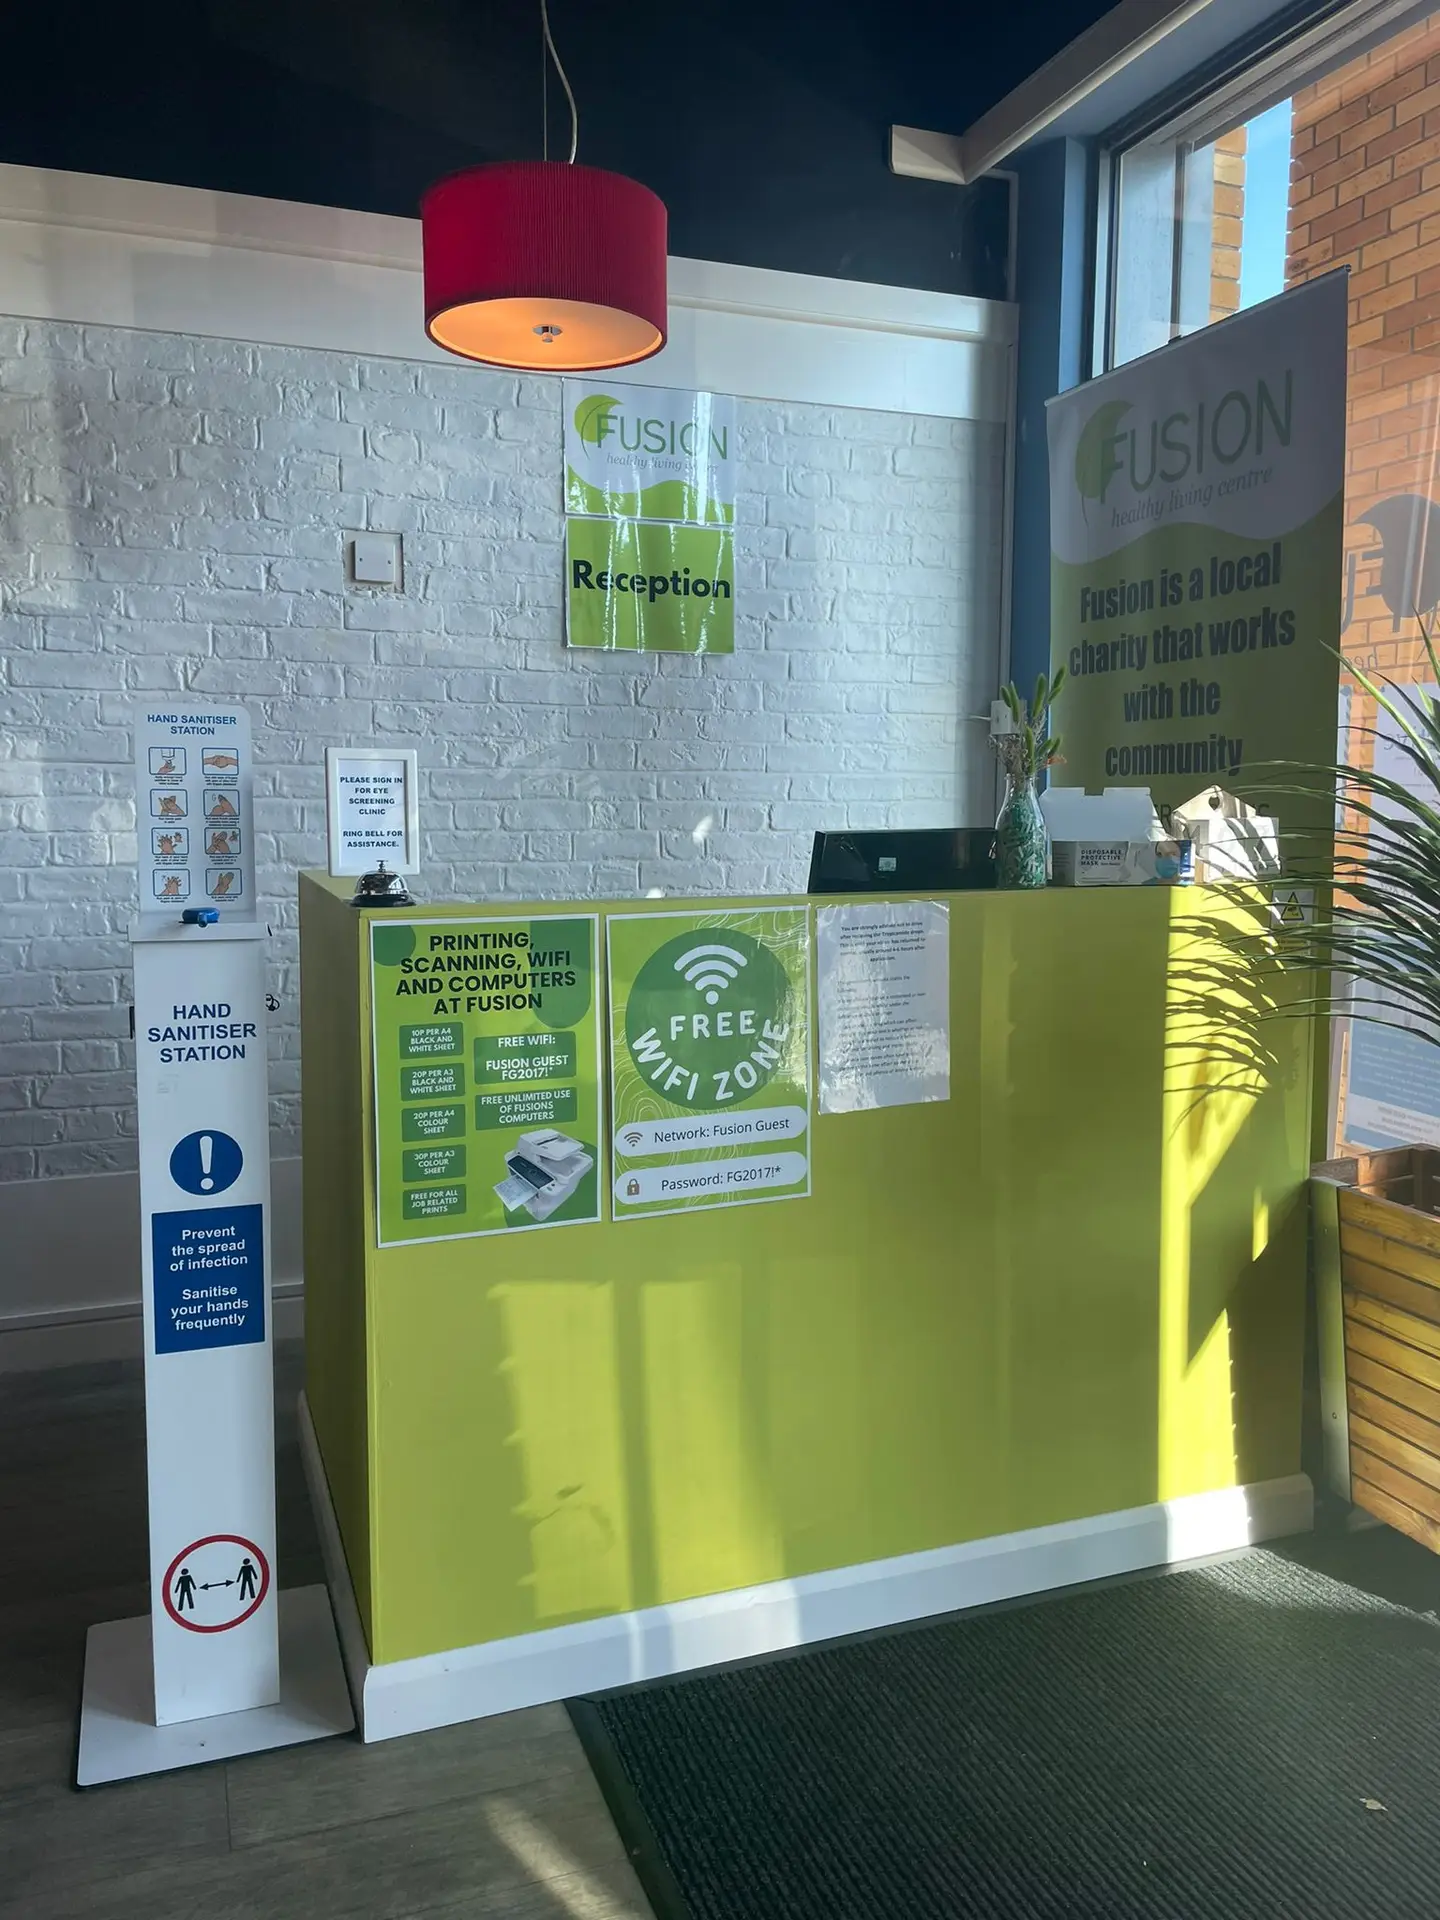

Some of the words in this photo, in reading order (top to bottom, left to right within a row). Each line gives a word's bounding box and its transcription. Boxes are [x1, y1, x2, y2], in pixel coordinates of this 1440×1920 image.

[597, 413, 727, 459] FUSION
[1100, 368, 1293, 504] FUSION
[1111, 497, 1166, 528] healthy
[1168, 482, 1213, 513] living
[1218, 465, 1273, 497] centre
[573, 559, 731, 602] Reception
[1080, 578, 1154, 623] Fusion
[1160, 568, 1183, 608] is
[1189, 567, 1204, 601] a
[1210, 542, 1282, 597] local
[1069, 632, 1148, 677] charity
[1153, 622, 1203, 664] that
[1209, 606, 1296, 656] works
[1124, 682, 1174, 722] with
[1180, 678, 1221, 718] the
[147, 714, 178, 723] HAND
[181, 715, 237, 725] SANITISER
[170, 726, 215, 735] STATION
[1105, 733, 1243, 777] community
[430, 932, 534, 951] PRINTING,
[401, 953, 522, 974] SCANNING,
[527, 951, 570, 968] WIFI
[396, 977, 443, 995] AND
[448, 971, 576, 992] COMPUTERS
[173, 1003, 231, 1020] HAND
[433, 997, 461, 1015] AT
[466, 993, 542, 1013] FUSION
[148, 1023, 257, 1042] SANITISER
[670, 1010, 756, 1042] FREE
[408, 1045, 432, 1053] WHITE
[434, 1043, 455, 1051] SHEET
[411, 1037, 435, 1045] BLACK
[498, 1036, 525, 1048] FREE
[527, 1034, 556, 1045] WIFI:
[160, 1044, 246, 1063] STATION
[632, 1028, 699, 1100] WIFI
[713, 1019, 789, 1101] ZONE
[486, 1058, 529, 1070] FUSION
[532, 1055, 569, 1067] GUEST
[428, 1069, 442, 1077] PER
[410, 1086, 433, 1094] WHITE
[435, 1084, 456, 1092] SHEET
[412, 1078, 436, 1086] BLACK
[481, 1096, 502, 1105] FREE
[504, 1091, 552, 1103] UNLIMITED
[553, 1089, 571, 1098] USE
[500, 1104, 512, 1113] OF
[514, 1101, 553, 1112] FUSIONS
[418, 1118, 448, 1127] COLOUR
[499, 1111, 554, 1123] COMPUTERS
[424, 1126, 445, 1135] SHEET
[654, 1126, 710, 1143] Network:
[713, 1122, 752, 1136] Fusion
[755, 1119, 790, 1132] Guest
[418, 1159, 449, 1167] COLOUR
[424, 1167, 445, 1175] SHEET
[661, 1173, 724, 1191] Password:
[411, 1192, 428, 1200] FREE
[429, 1190, 444, 1198] FOR
[445, 1189, 458, 1197] ALL
[427, 1197, 458, 1206] RELATED
[422, 1206, 448, 1215] PRINTS
[182, 1226, 236, 1240] Prevent
[172, 1245, 194, 1257] the
[198, 1239, 245, 1256] spread
[170, 1259, 184, 1272] of
[188, 1255, 248, 1270] infection
[182, 1285, 238, 1300] Sanitise
[171, 1304, 203, 1319] your
[207, 1298, 249, 1312] hands
[175, 1313, 245, 1331] frequently
